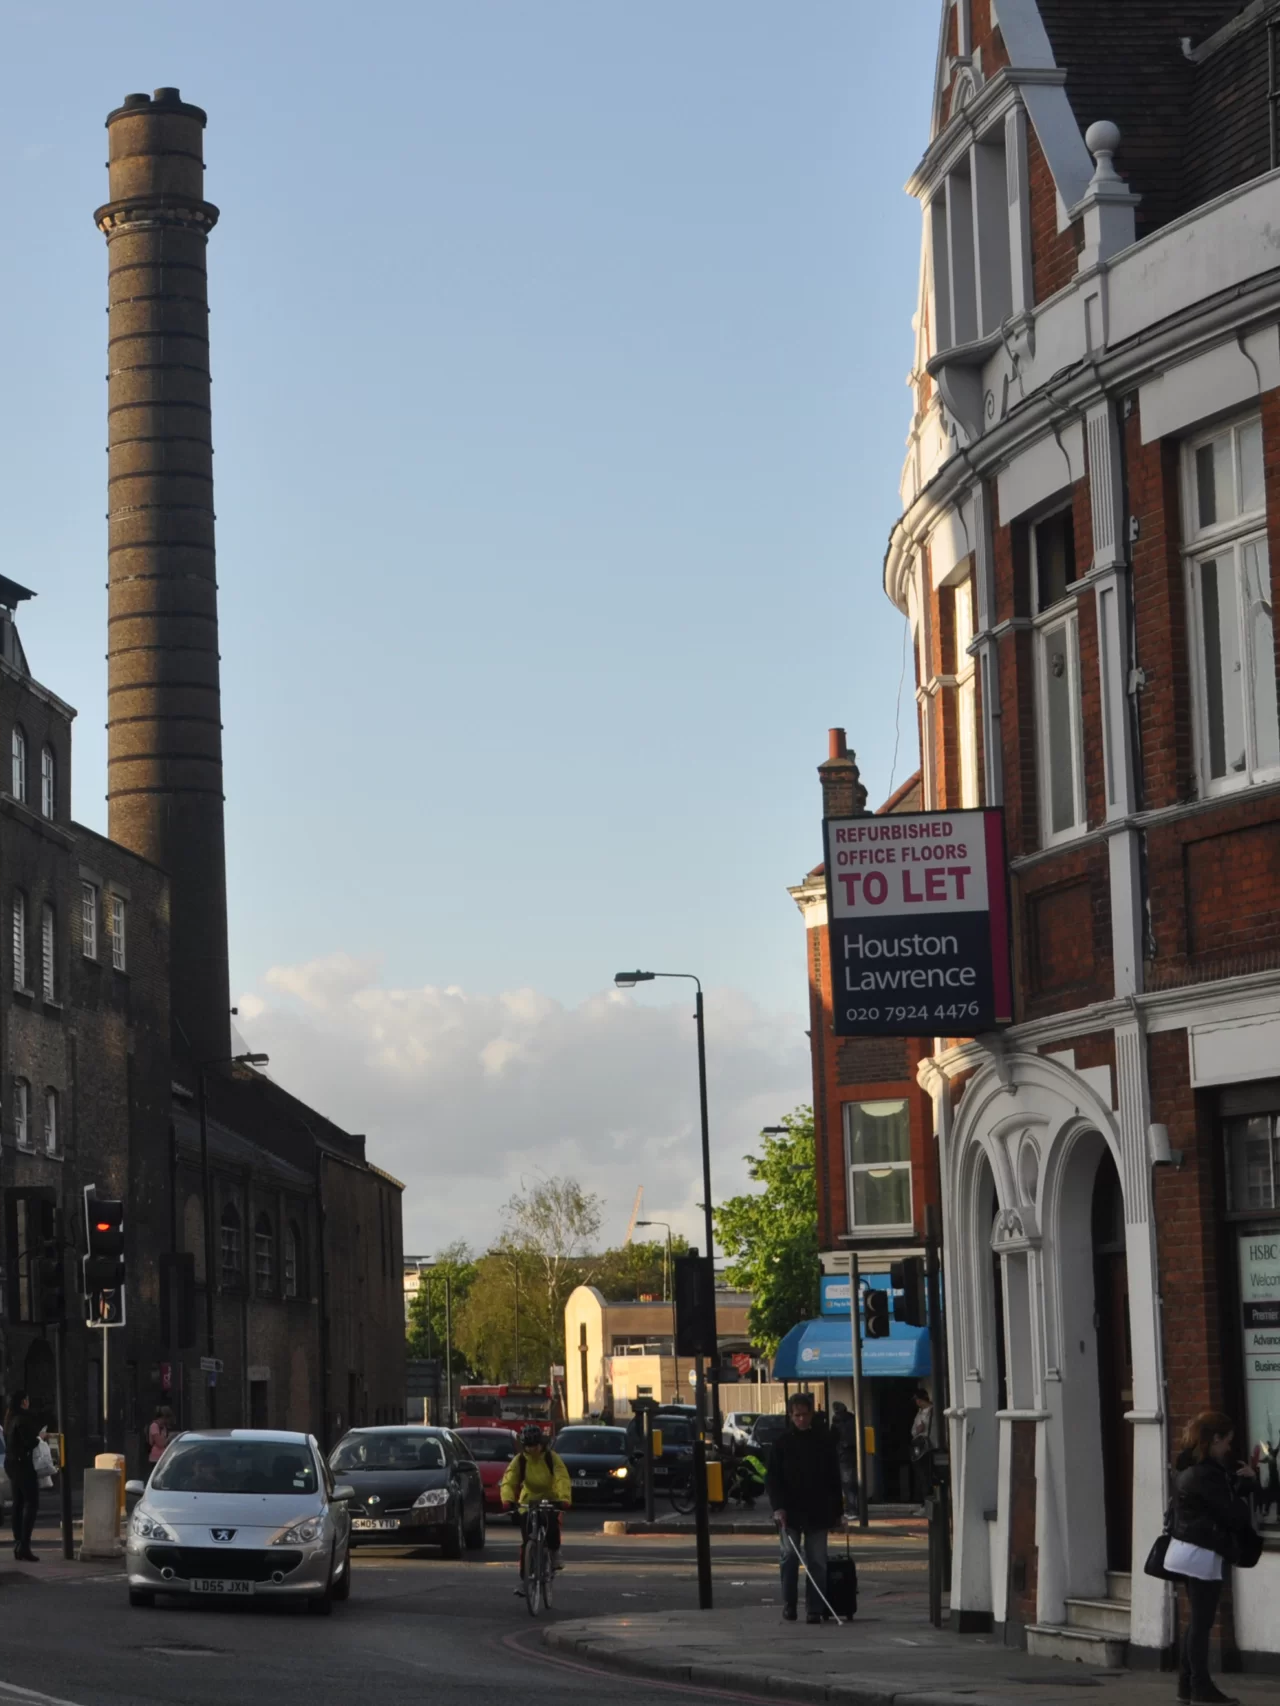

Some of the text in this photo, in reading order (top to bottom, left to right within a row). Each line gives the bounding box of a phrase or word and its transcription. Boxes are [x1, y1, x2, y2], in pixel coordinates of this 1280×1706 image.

[836, 821, 953, 844] REFURBISHED
[837, 843, 968, 866] OFFICE FLOORS
[838, 866, 972, 906] TO LET
[844, 933, 958, 960] Houston
[845, 966, 977, 991] Lawrence
[846, 1000, 980, 1021] 020 7924 4476
[1249, 1243, 1278, 1261] HSBC
[1252, 1307, 1279, 1321] Premier
[227, 1581, 250, 1593] JXN
